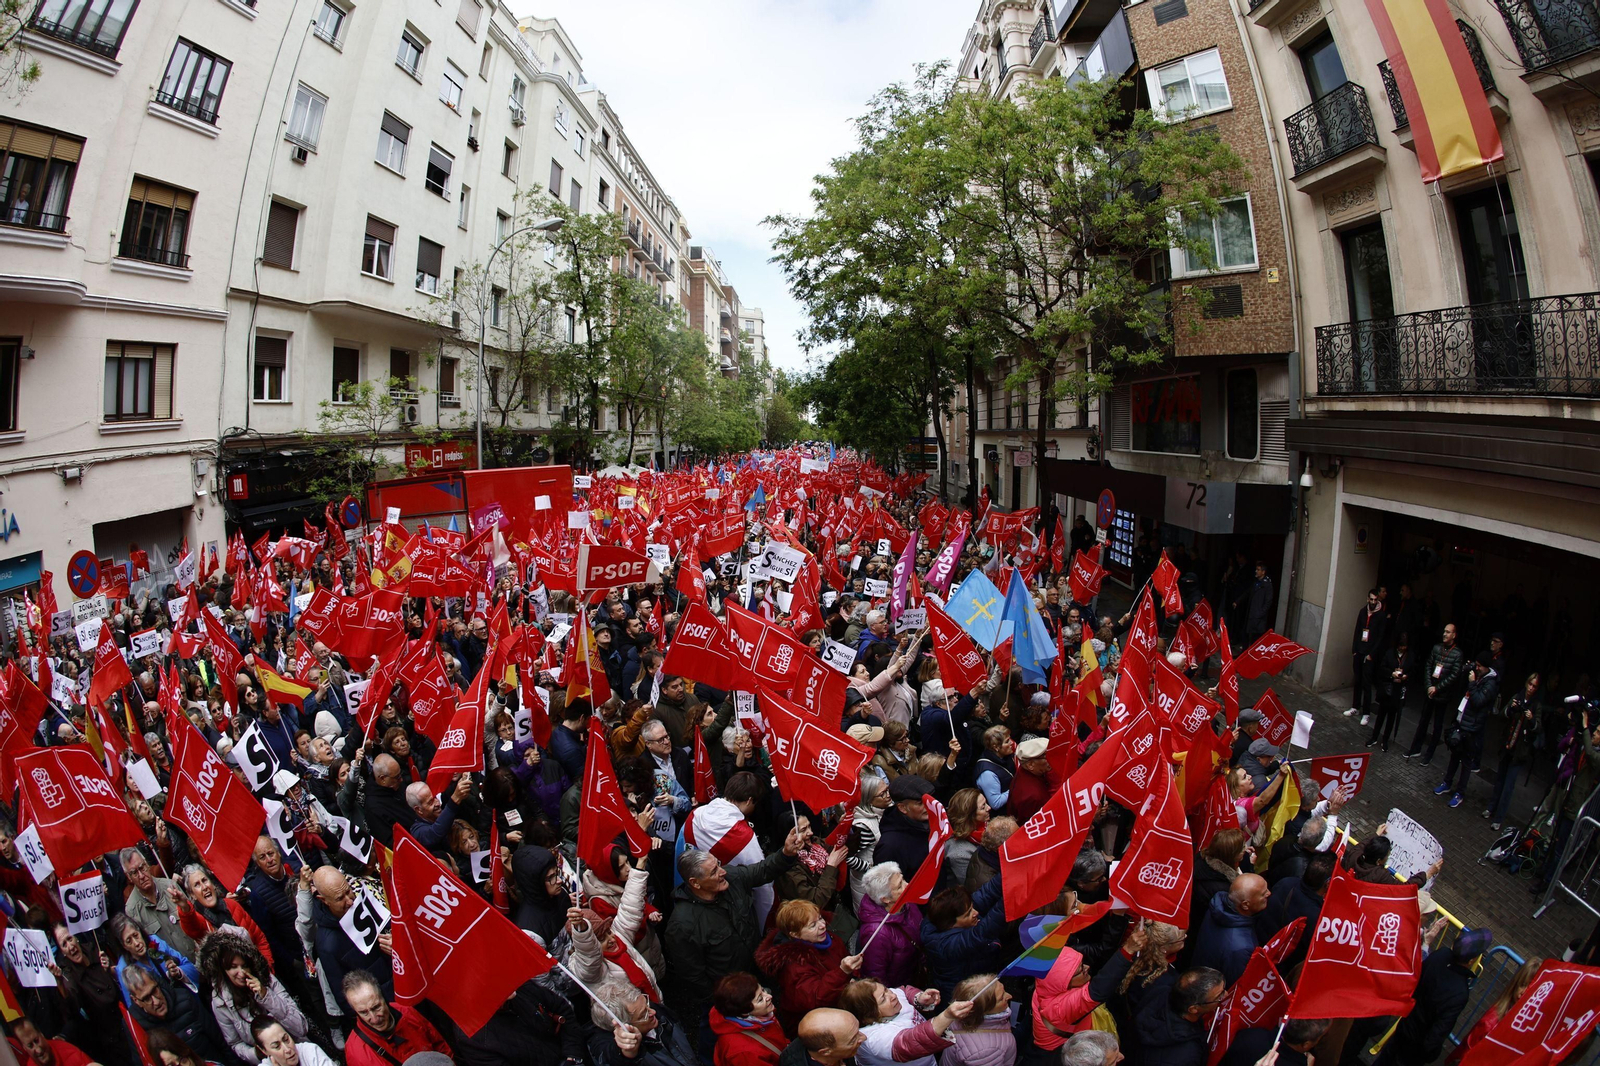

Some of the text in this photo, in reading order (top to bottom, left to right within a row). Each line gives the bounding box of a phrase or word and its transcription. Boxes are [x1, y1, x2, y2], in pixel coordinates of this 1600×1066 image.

[1186, 481, 1207, 510] 72
[485, 508, 504, 526] PSOE
[535, 556, 551, 568] SOE
[723, 563, 738, 575] SÍ
[413, 572, 433, 581] PSOE
[590, 562, 646, 581] PSOE
[683, 622, 711, 640] PSOE
[1316, 916, 1360, 947] PSOE
